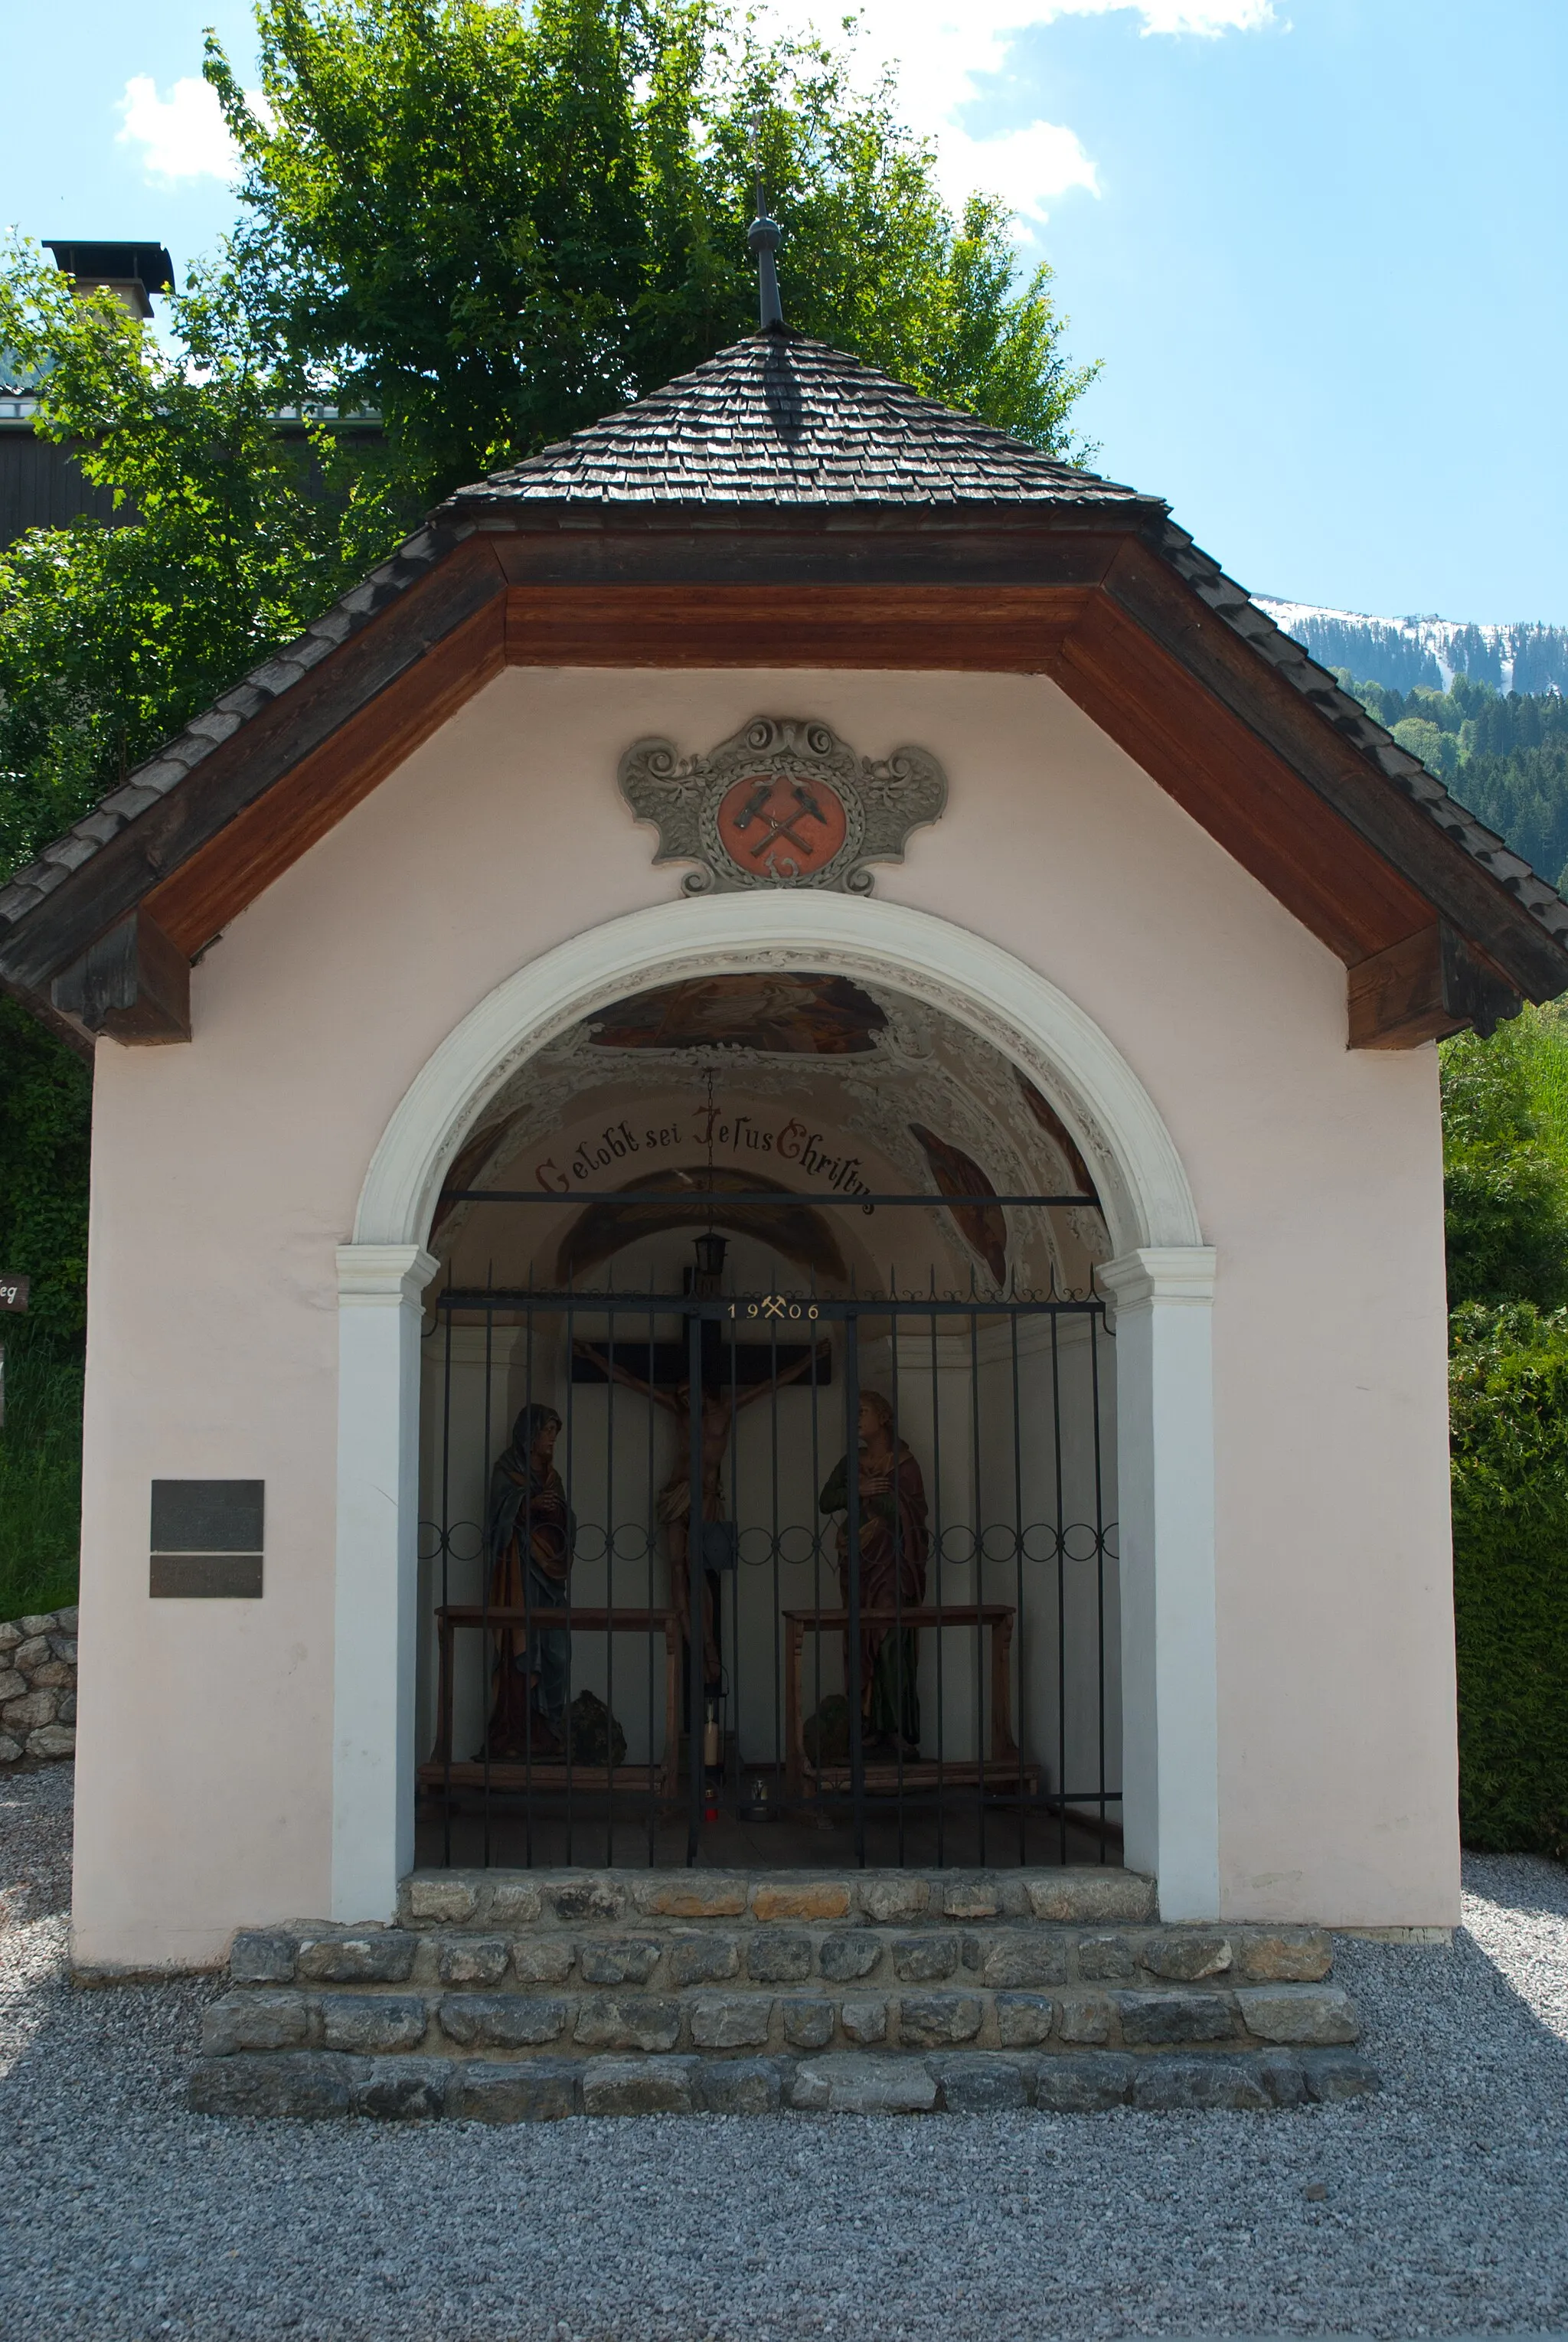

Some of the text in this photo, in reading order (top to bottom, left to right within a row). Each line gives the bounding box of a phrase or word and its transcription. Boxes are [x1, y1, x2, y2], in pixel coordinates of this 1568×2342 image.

[535, 1119, 640, 1194] Gelobt
[645, 1122, 682, 1148] sei
[0, 1279, 18, 1305] eg
